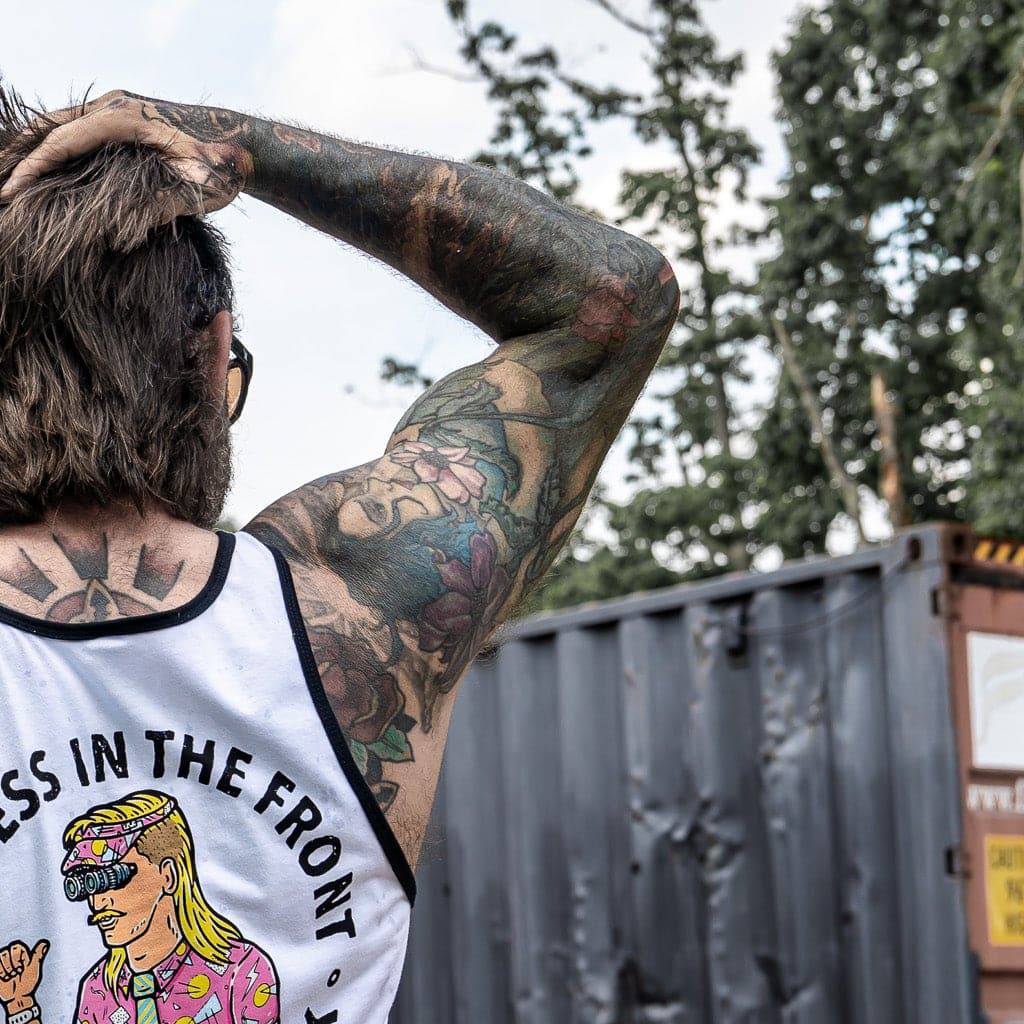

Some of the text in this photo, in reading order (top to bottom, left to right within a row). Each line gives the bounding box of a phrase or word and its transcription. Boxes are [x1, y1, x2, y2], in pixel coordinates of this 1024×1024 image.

[70, 731, 129, 786] IN
[145, 730, 253, 798] THE
[253, 771, 357, 940] FRONT
